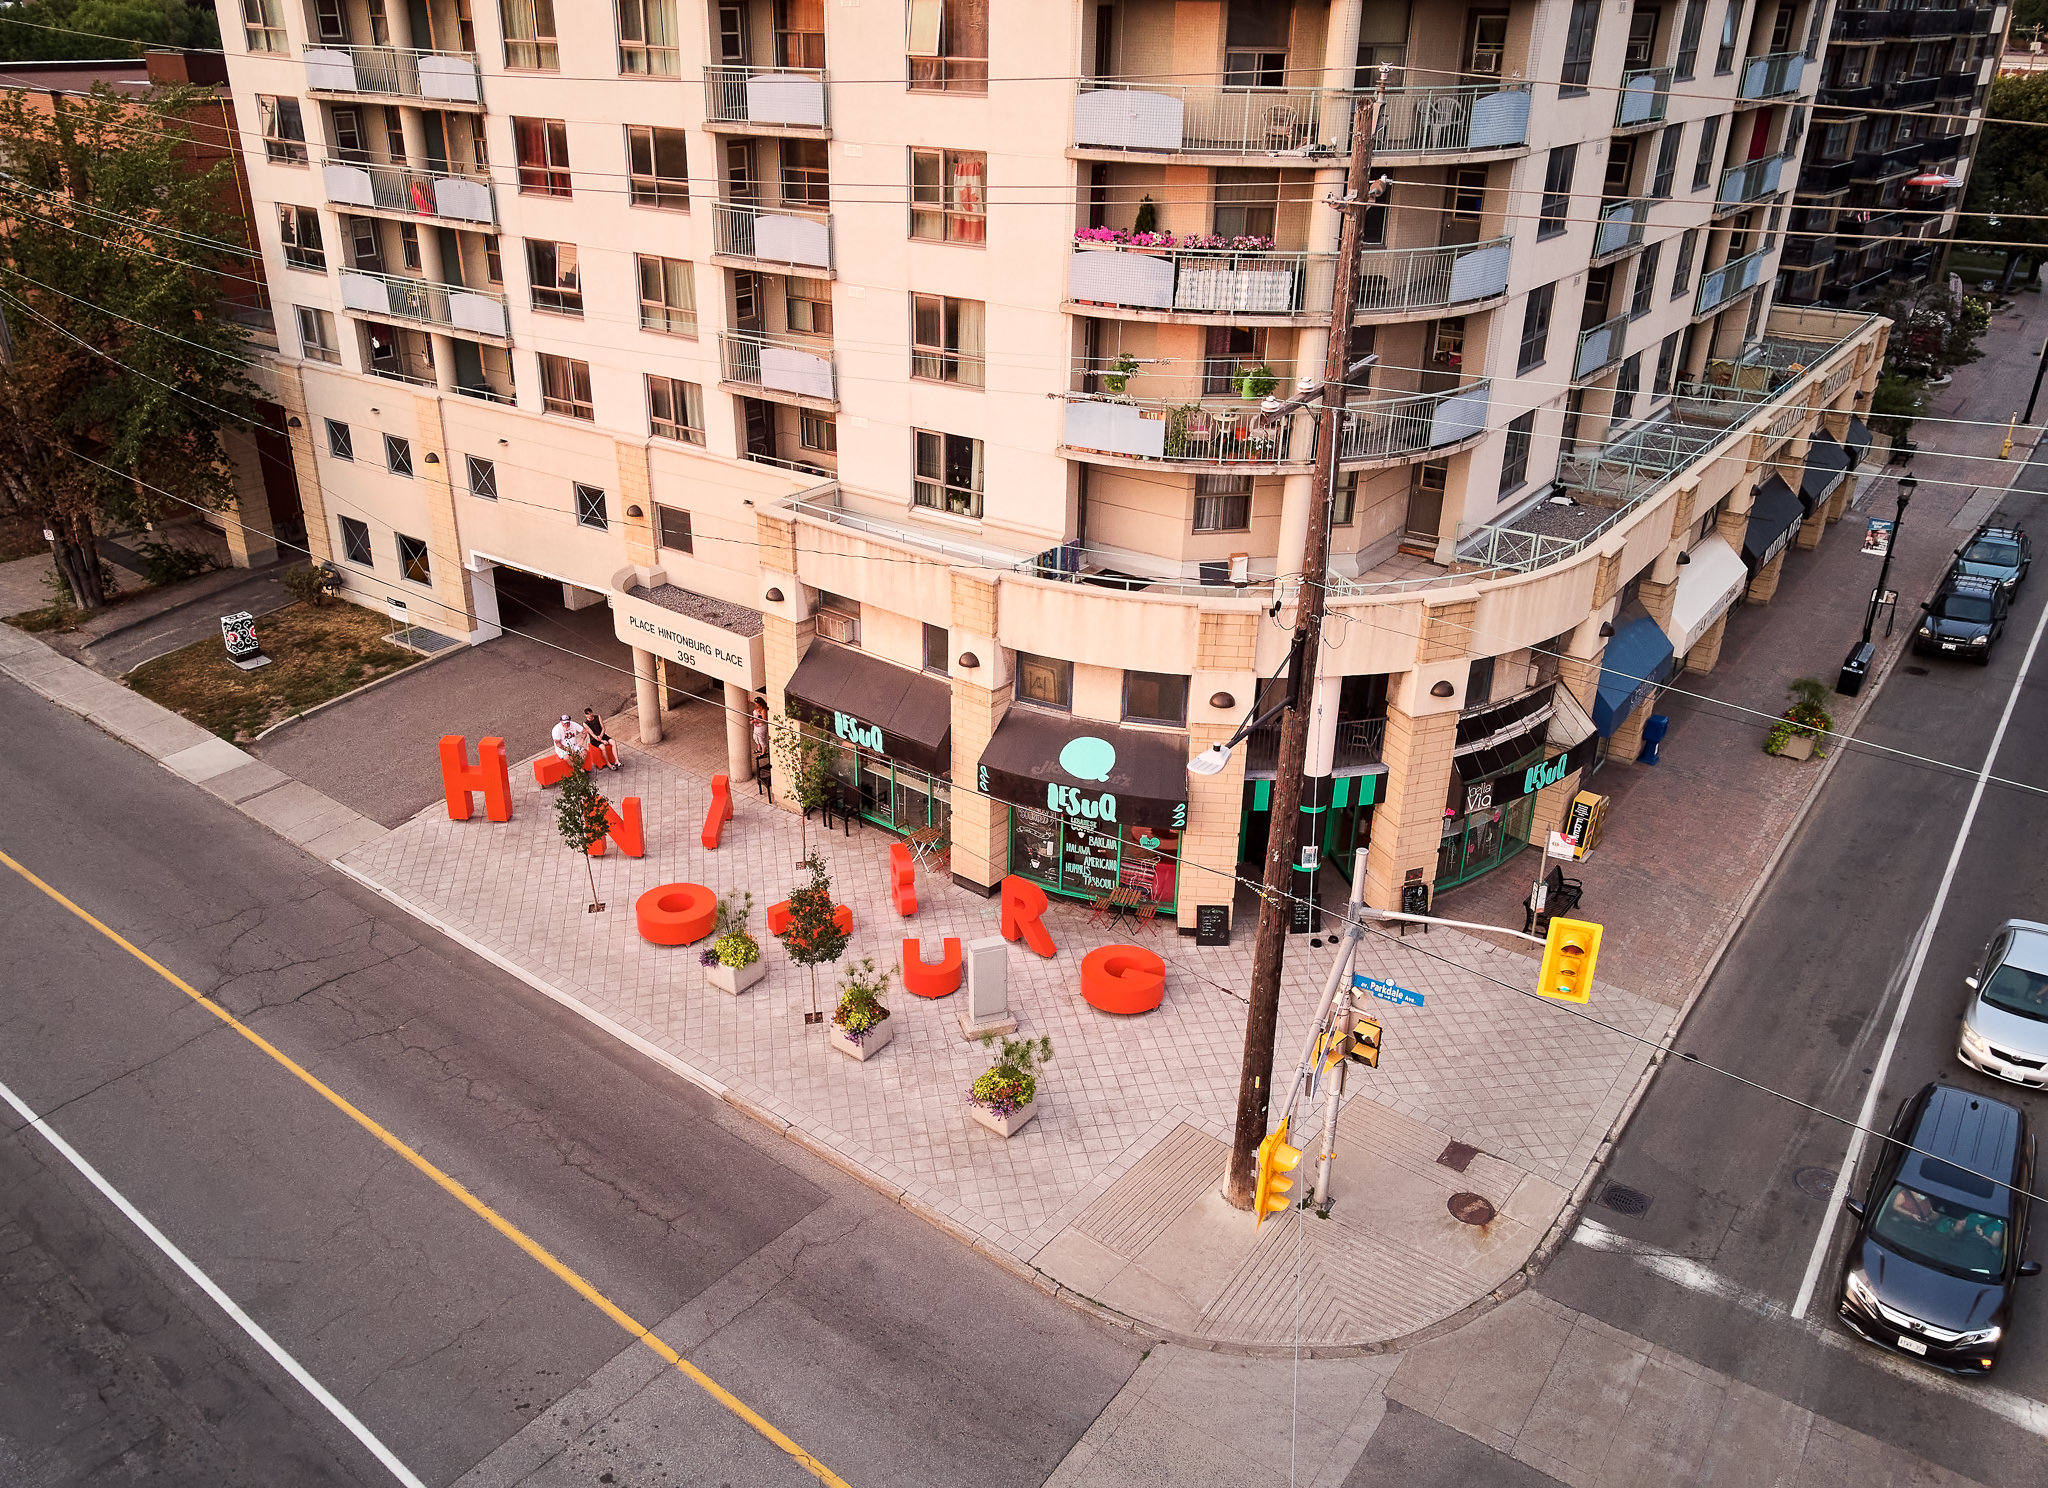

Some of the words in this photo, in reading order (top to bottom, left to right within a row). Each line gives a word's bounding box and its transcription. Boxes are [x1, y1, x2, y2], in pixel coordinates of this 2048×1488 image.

[629, 615, 656, 635] PLACE
[657, 626, 712, 656] HINTONBURG
[714, 647, 743, 668] PLACE
[677, 650, 696, 667] 395
[1467, 794, 1492, 811] Via
[1065, 842, 1092, 856] HALAWA
[1088, 835, 1118, 851] BAKLAVA
[1065, 862, 1092, 876] HUMMUS
[1370, 981, 1404, 999] Parkdale
[1404, 995, 1417, 1004] Ave.
